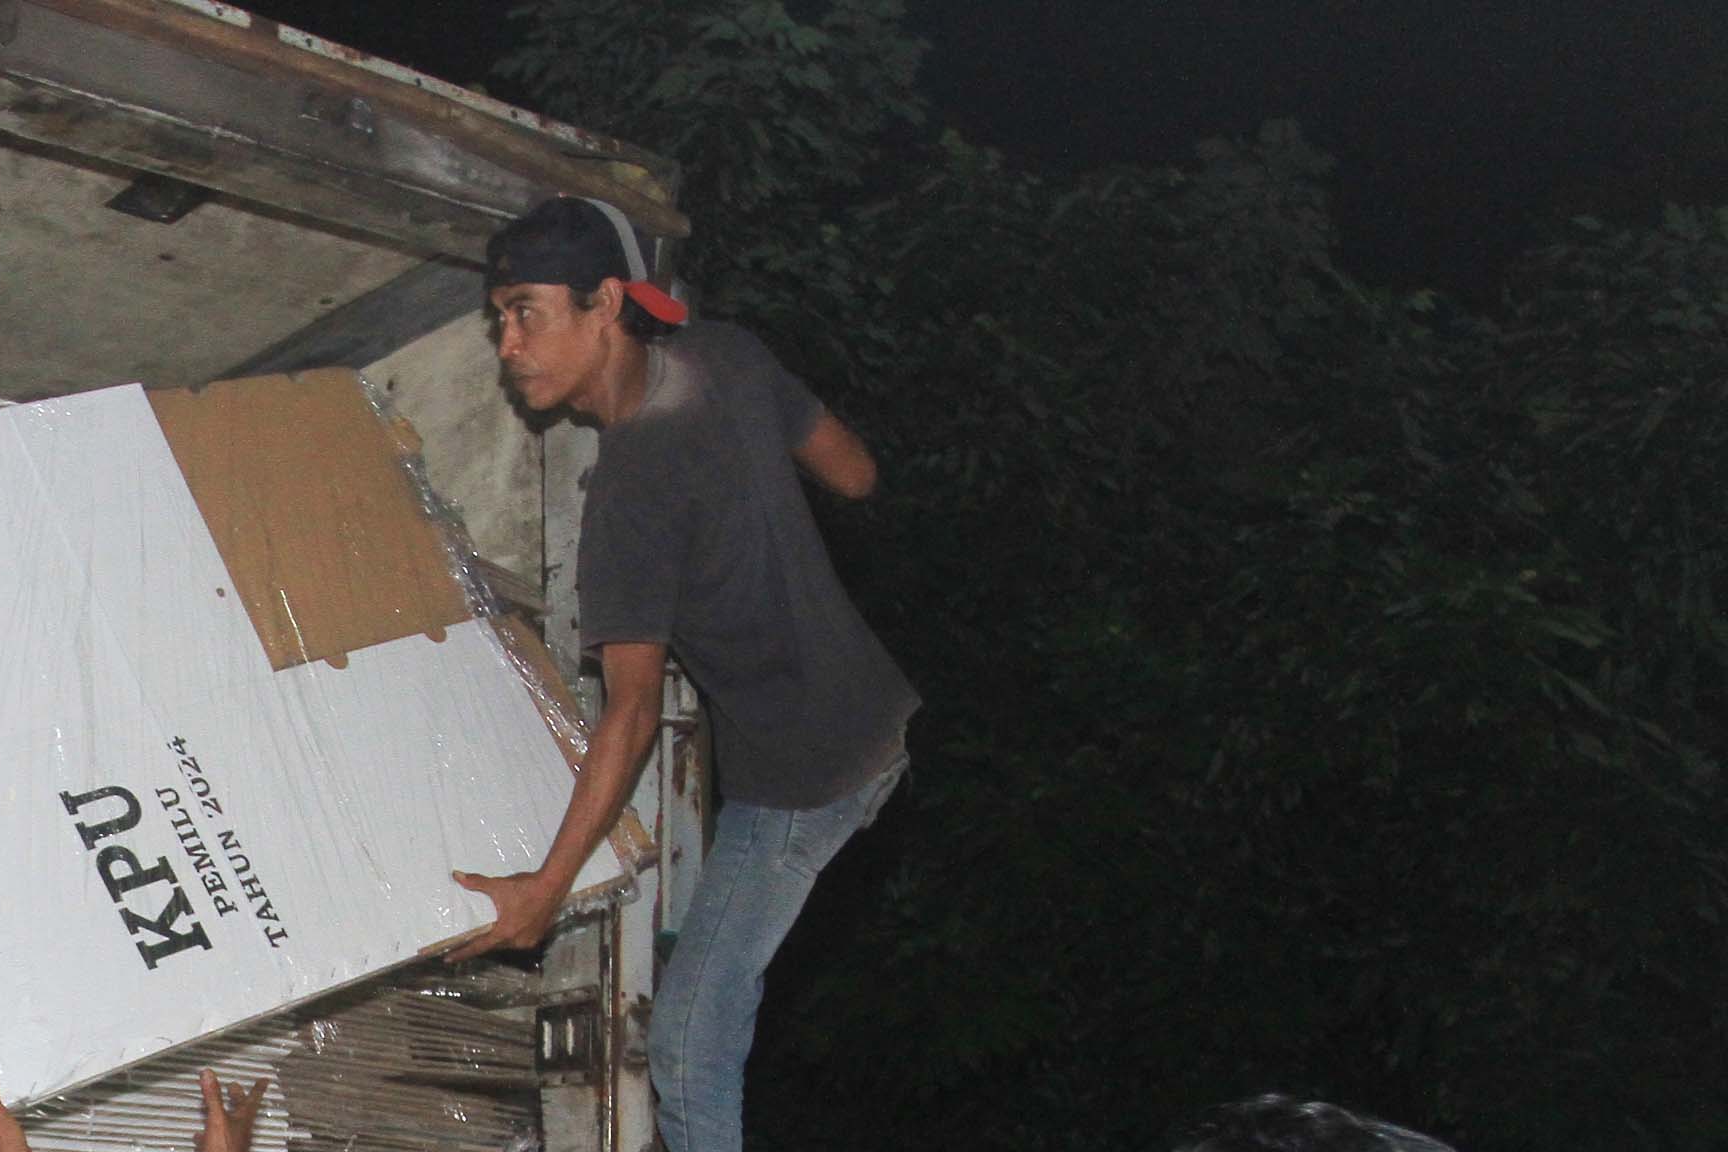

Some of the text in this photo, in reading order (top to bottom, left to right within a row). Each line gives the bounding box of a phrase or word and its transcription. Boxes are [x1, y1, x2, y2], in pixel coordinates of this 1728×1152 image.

[58, 785, 213, 970] KPU
[155, 787, 239, 917] PEMILU
[167, 735, 289, 948] TAHUN 2024
